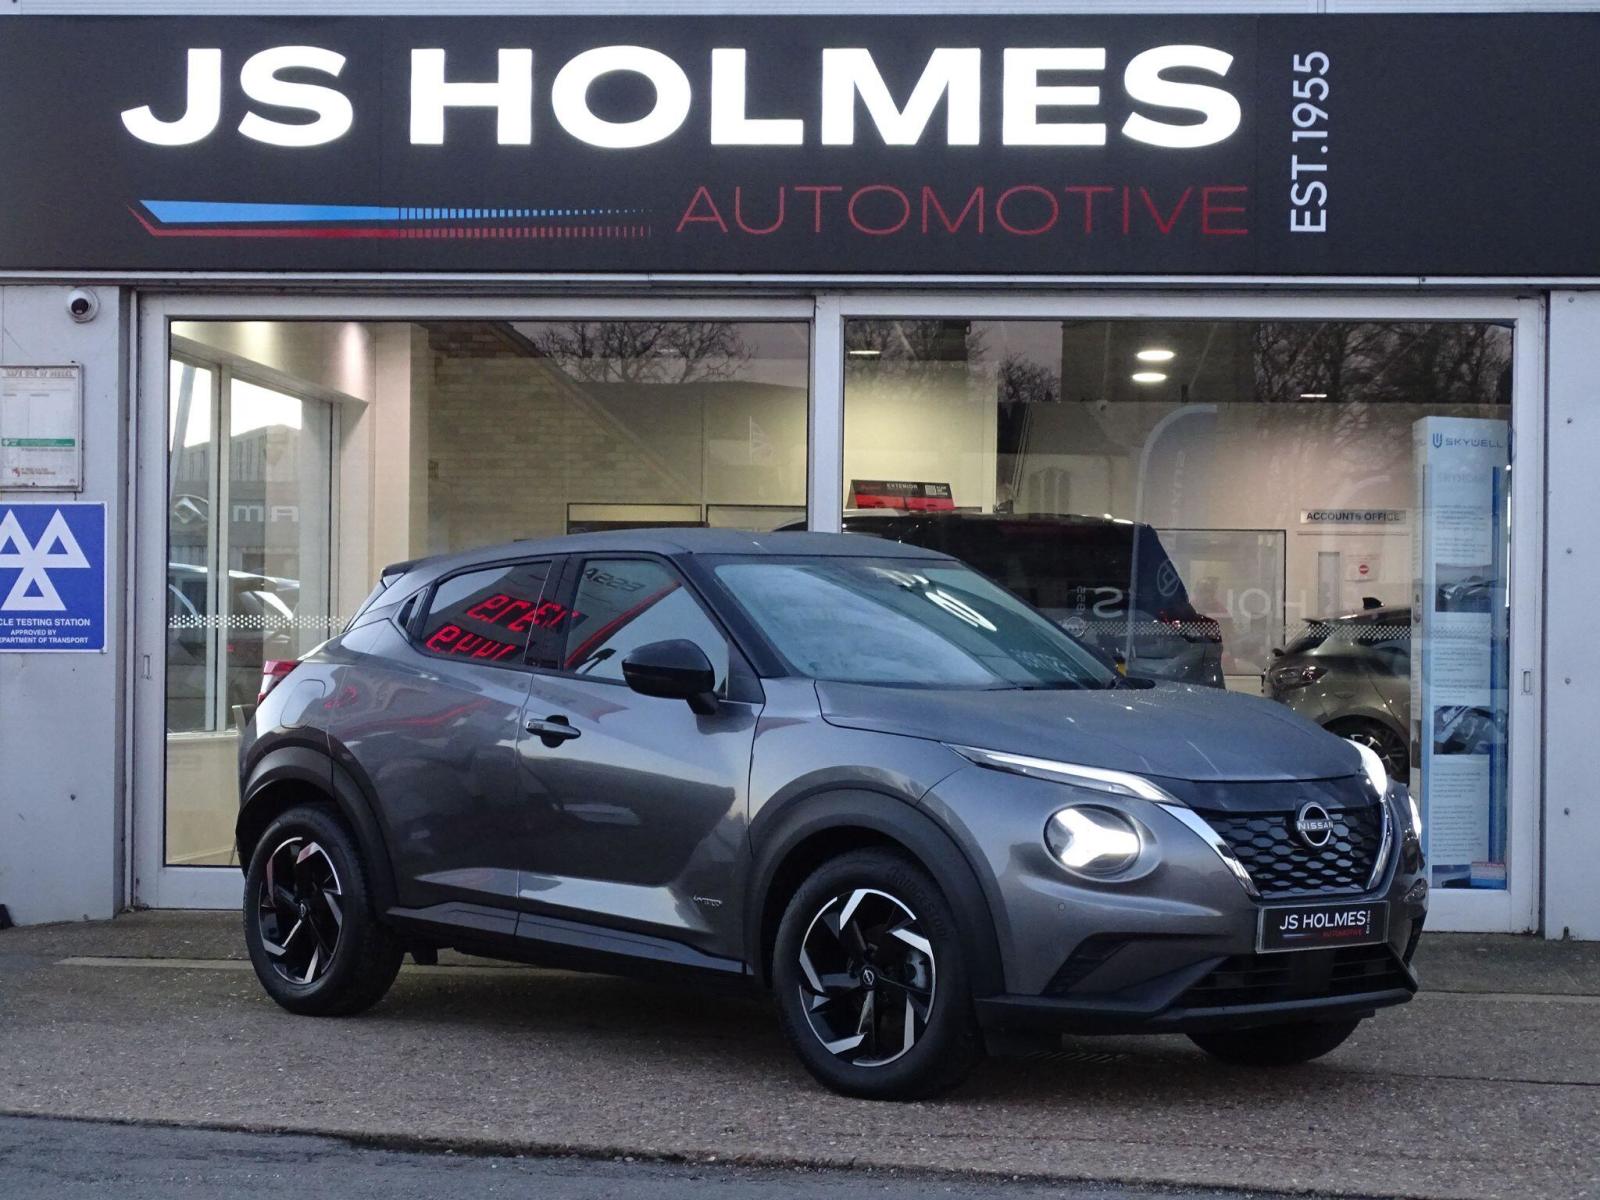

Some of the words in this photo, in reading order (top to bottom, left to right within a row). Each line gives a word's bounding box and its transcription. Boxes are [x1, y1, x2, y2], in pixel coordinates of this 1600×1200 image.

[120, 45, 354, 148] JS
[408, 44, 1243, 149] HOLMES
[1289, 50, 1331, 234] EST.1955
[675, 184, 1250, 237] AUTOMOTIVE
[1445, 438, 1504, 449] SKYWELL
[1306, 512, 1362, 522] ACCOUNTS
[1364, 512, 1401, 522] OFFICE
[16, 618, 53, 626] TESTING
[54, 618, 91, 626] STATION
[1297, 821, 1334, 831] NISSAN
[1279, 914, 1299, 931] JS
[1303, 911, 1366, 928] HOLMES
